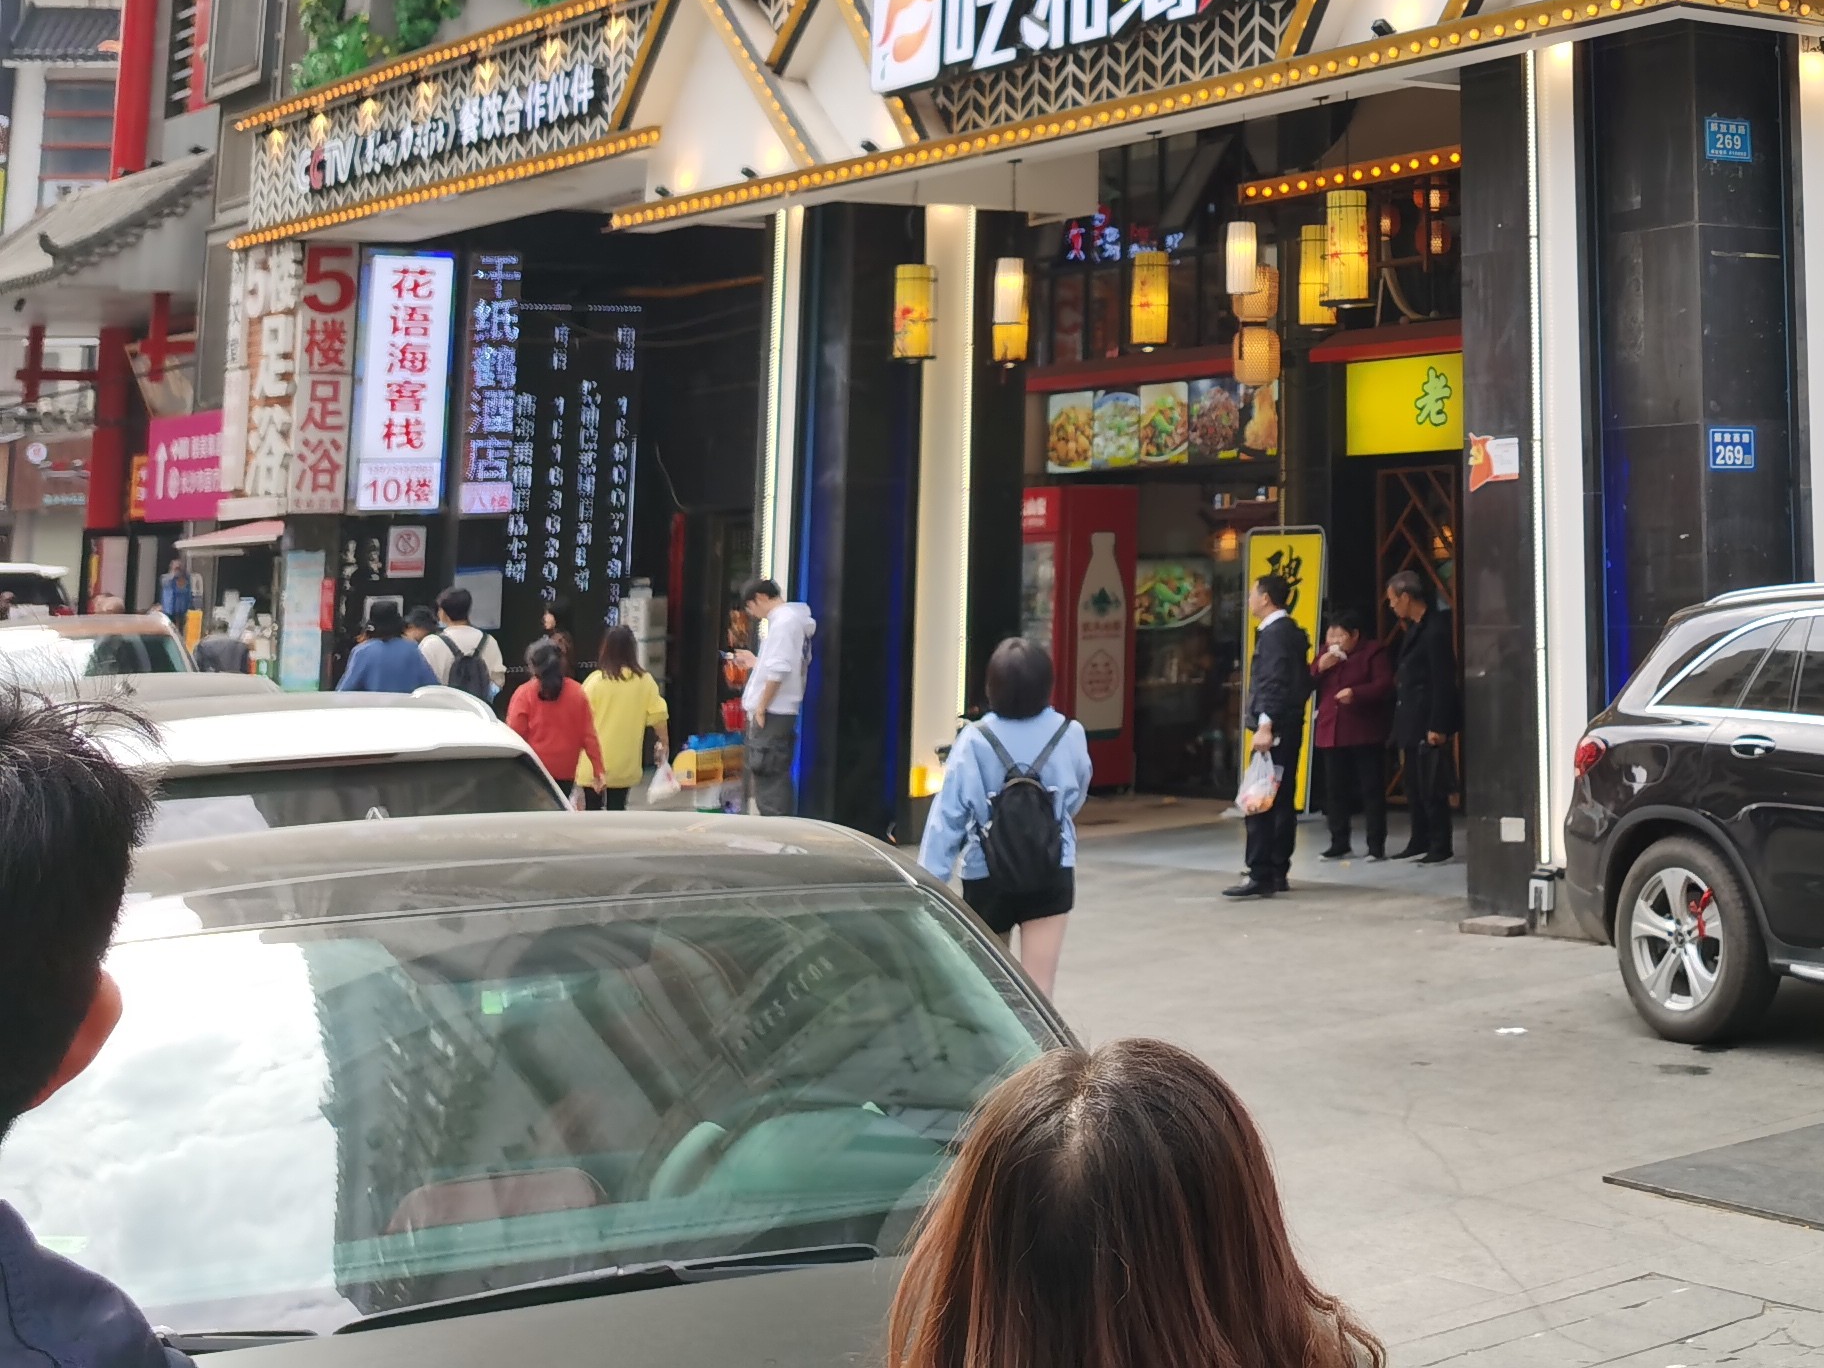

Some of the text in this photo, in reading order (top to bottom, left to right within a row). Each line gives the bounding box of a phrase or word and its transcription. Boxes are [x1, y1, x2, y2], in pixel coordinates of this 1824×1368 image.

[1715, 133, 1742, 150] 269
[382, 265, 437, 451] 花语海客栈
[1715, 444, 1744, 465] 269
[364, 477, 433, 505] 10楼
